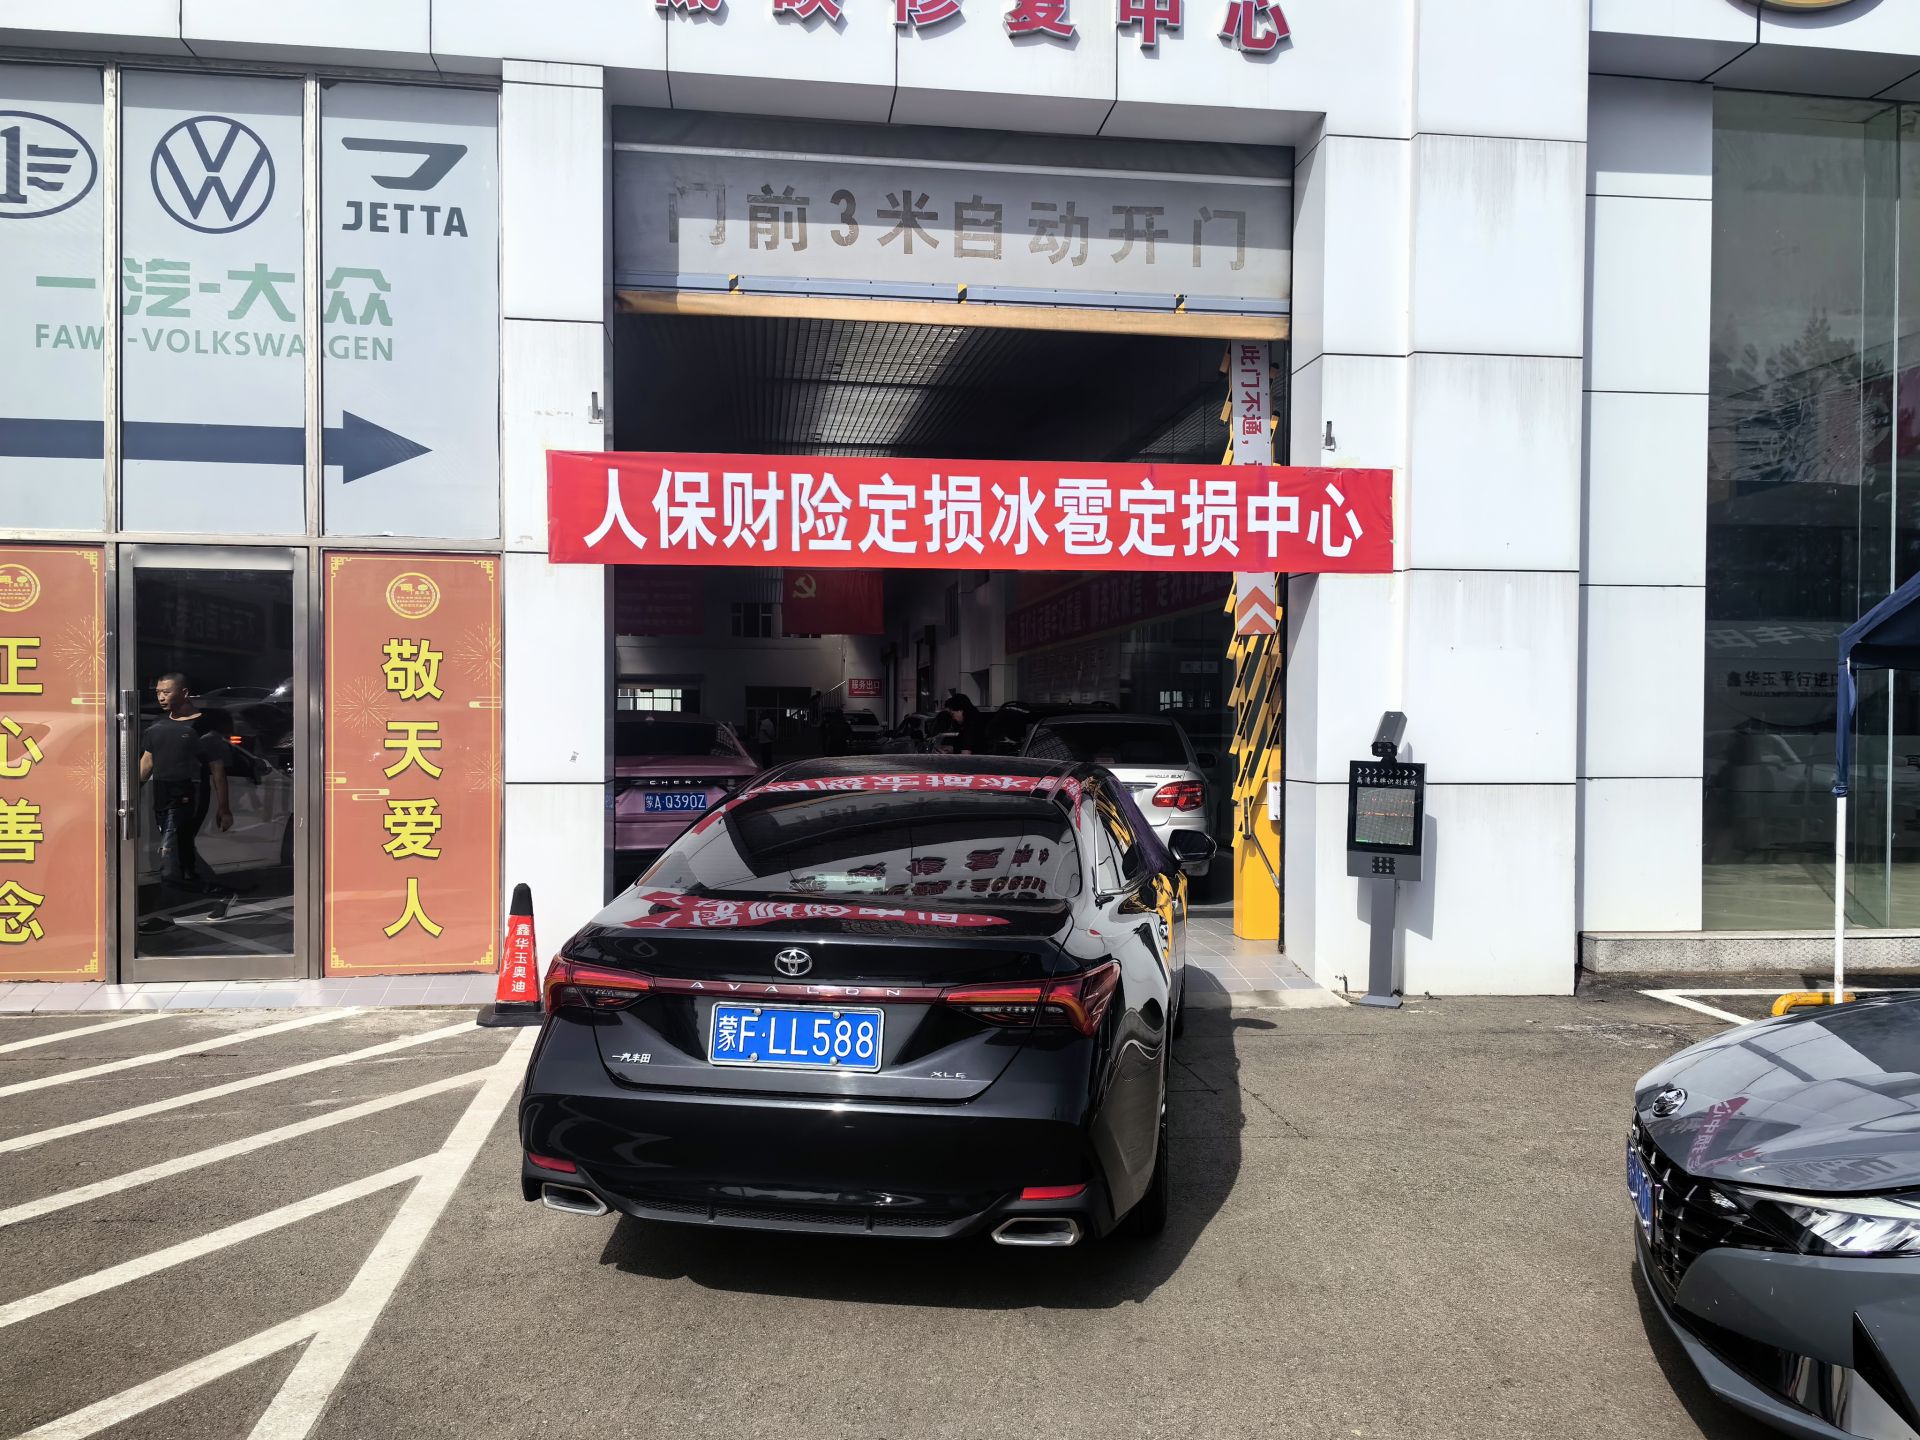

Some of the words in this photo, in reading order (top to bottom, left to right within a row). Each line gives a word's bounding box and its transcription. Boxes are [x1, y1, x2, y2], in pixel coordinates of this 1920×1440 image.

[342, 201, 468, 237] JETTA
[668, 182, 1246, 271] 门前3米自动开门
[583, 468, 1364, 558] 人保财险定损冰雹定损中心
[380, 637, 445, 939] 敬天爱人
[511, 923, 531, 993] 鑫华玉奥迪
[690, 981, 901, 996] AVALON
[611, 1053, 651, 1065] 一汽丰田
[930, 1071, 967, 1079] XLE
